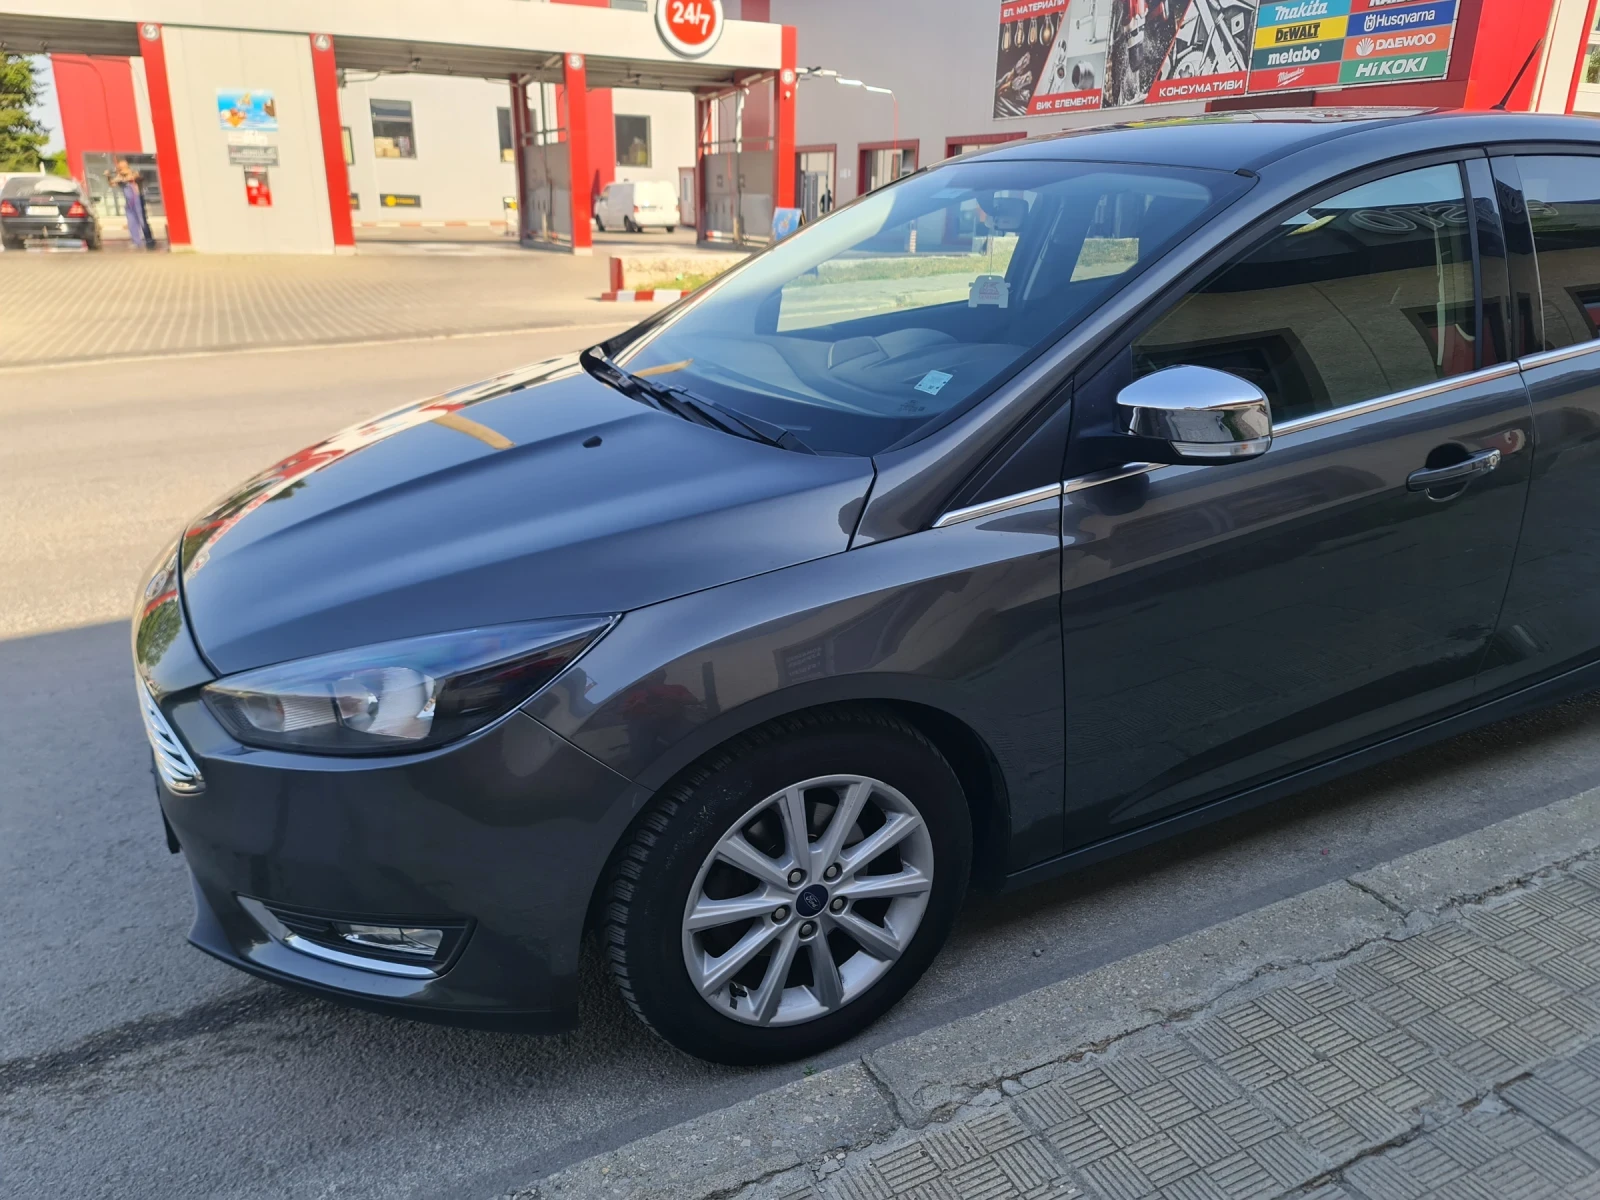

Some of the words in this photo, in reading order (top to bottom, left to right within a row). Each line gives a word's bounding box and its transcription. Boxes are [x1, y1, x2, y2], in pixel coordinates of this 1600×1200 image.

[672, 1, 711, 36] 24/7
[1376, 9, 1436, 27] Husqvarna
[1375, 33, 1437, 51] DAEWOO
[1267, 46, 1321, 65] metabo
[1355, 57, 1428, 78] HiKOKI
[1159, 79, 1243, 97] КОНСУМАТИВИ
[1054, 95, 1099, 108] ЕЛЕМЕНТИ
